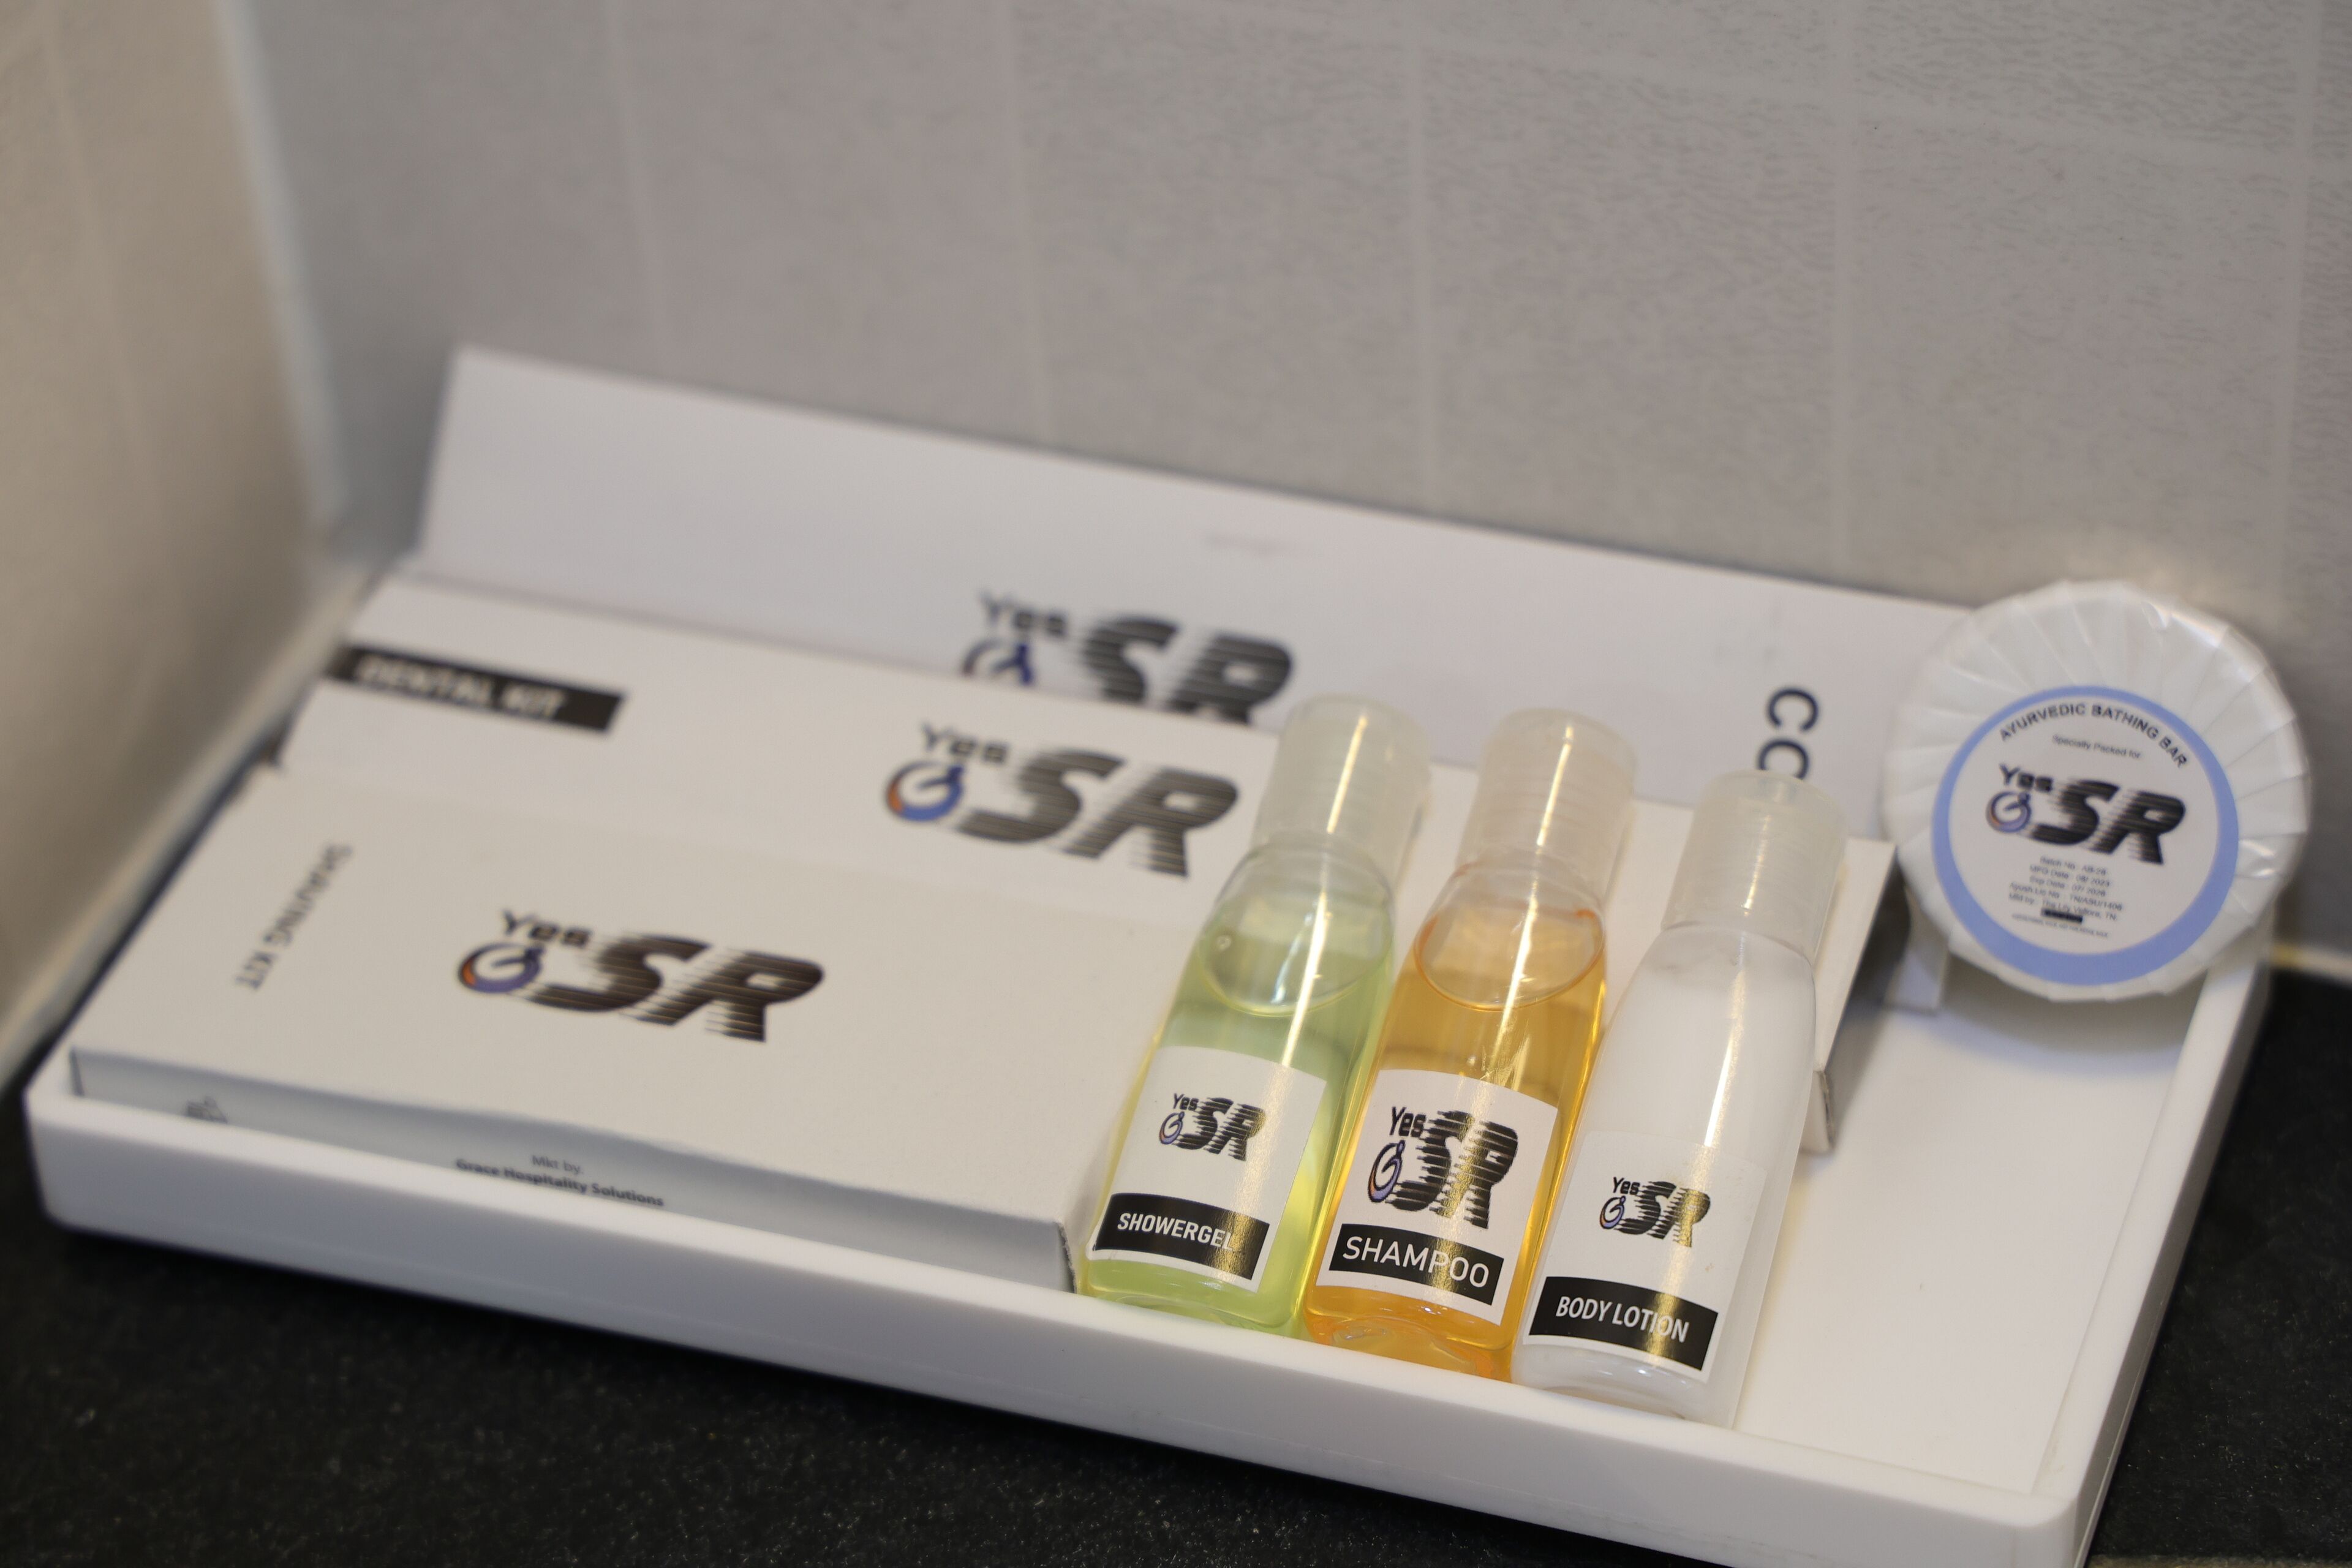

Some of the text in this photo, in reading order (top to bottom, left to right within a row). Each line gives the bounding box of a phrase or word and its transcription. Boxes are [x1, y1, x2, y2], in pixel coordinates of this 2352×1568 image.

[2000, 703, 2188, 767] AYURVEDIC BATHING BAR
[2052, 734, 2141, 759] Specially Packed for
[1999, 763, 2052, 793] Yes
[502, 910, 593, 948] Yes
[1173, 1093, 1199, 1111] Yes
[1389, 1106, 1426, 1137] Yes
[456, 1159, 663, 1206] Grace Hospitality Solutions
[1613, 1177, 1640, 1195] Yes
[1117, 1213, 1234, 1250] SHOWERGEL
[1342, 1236, 1490, 1287] SHAMPOO
[1556, 1296, 1689, 1343] BODY LOTION
